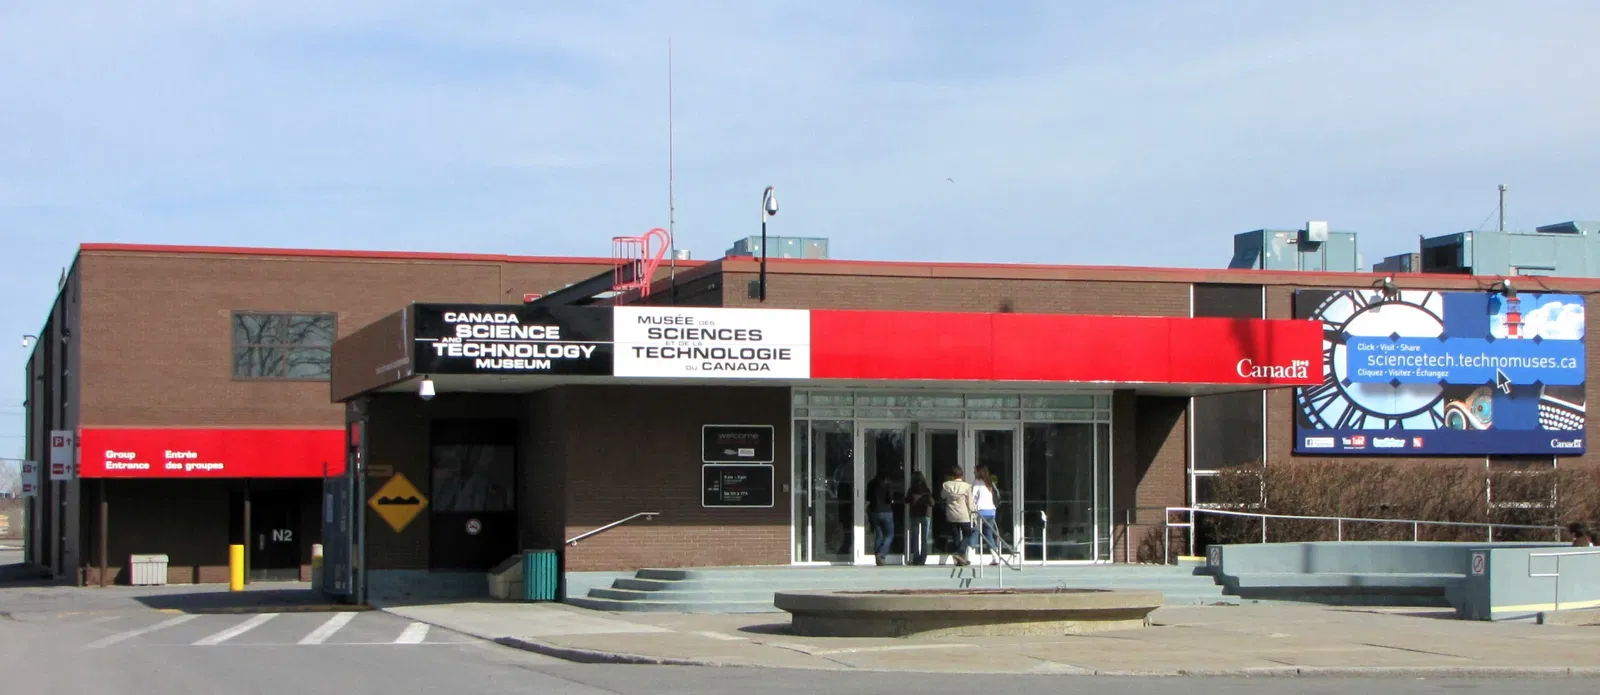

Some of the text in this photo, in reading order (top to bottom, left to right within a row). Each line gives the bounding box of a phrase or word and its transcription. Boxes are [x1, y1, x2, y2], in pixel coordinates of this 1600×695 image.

[444, 312, 519, 324] CANADA
[637, 314, 694, 325] MUSÉE
[455, 324, 560, 340] SCIENCE
[647, 327, 763, 341] SCIENCES
[432, 343, 597, 359] TECHNOLOGY
[1357, 343, 1421, 352] Click Visit Share
[632, 346, 792, 361] TECHNOLOGIE
[475, 359, 551, 370] MUSEUM
[1367, 351, 1577, 369] sciencetech.technomuses.ca
[701, 362, 770, 372] CANADA
[1236, 358, 1309, 378] Canada
[1357, 368, 1449, 379] Cliquez Visitez Échangez
[105, 450, 136, 460] Group
[165, 450, 198, 459] Entrée
[105, 461, 150, 470] Entrance
[165, 461, 224, 471] des groupes
[272, 529, 293, 541] N2
